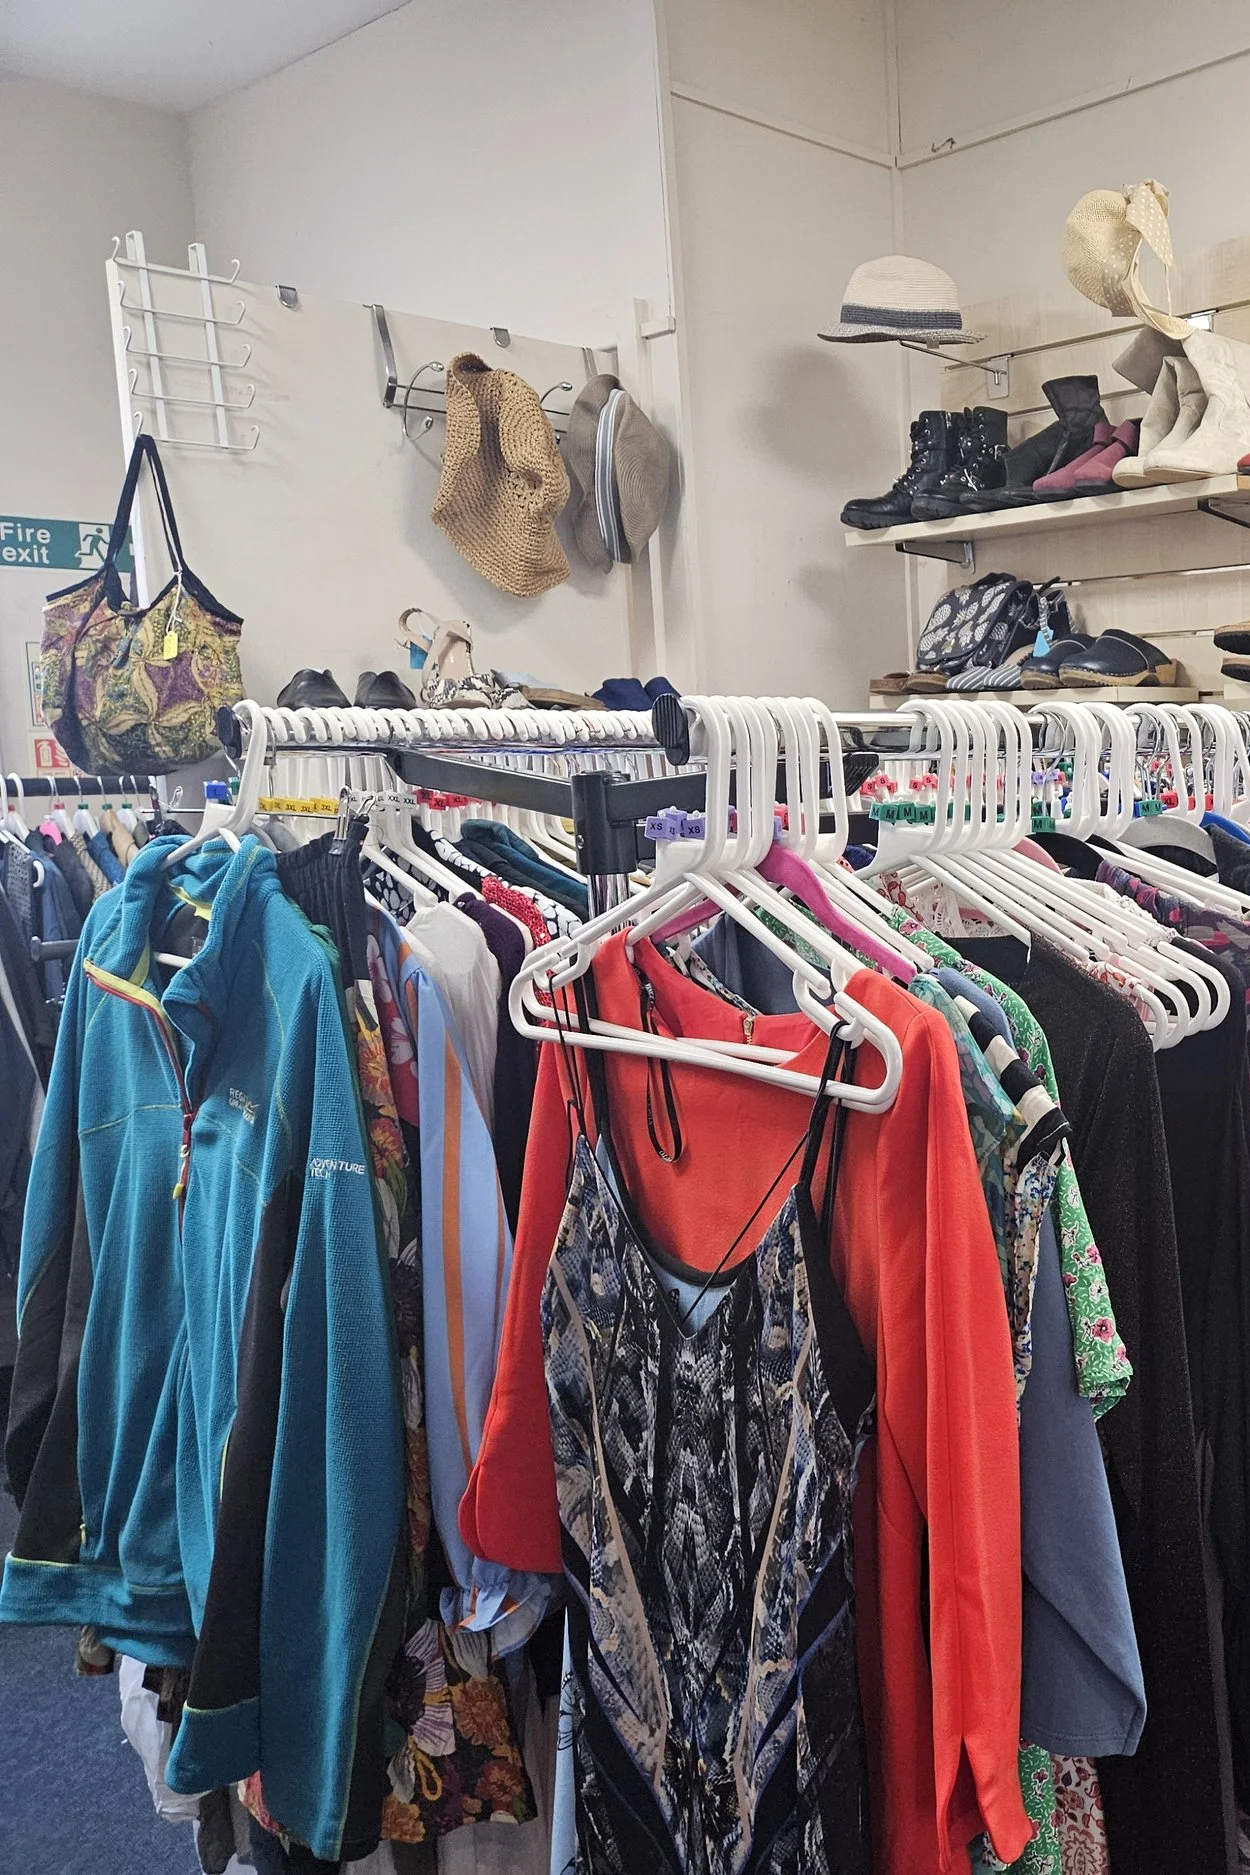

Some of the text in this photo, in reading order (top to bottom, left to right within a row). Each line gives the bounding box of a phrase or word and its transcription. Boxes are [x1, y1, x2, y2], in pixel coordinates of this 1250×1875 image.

[0, 522, 51, 544] Fire
[2, 545, 50, 564] exit
[867, 782, 873, 790] S
[880, 777, 886, 785] S
[913, 781, 918, 789] S
[388, 795, 400, 803] XXL
[404, 797, 415, 805] XXL
[1163, 797, 1175, 806] XL
[871, 806, 880, 817] M
[903, 806, 912, 818] M
[1142, 804, 1150, 813] M
[885, 808, 896, 820] M
[919, 809, 929, 820] M
[650, 821, 663, 831] XS
[1033, 820, 1043, 829] M
[687, 825, 701, 835] XS
[310, 1158, 366, 1175] ADVENTURE
[311, 1167, 331, 1179] TECH
